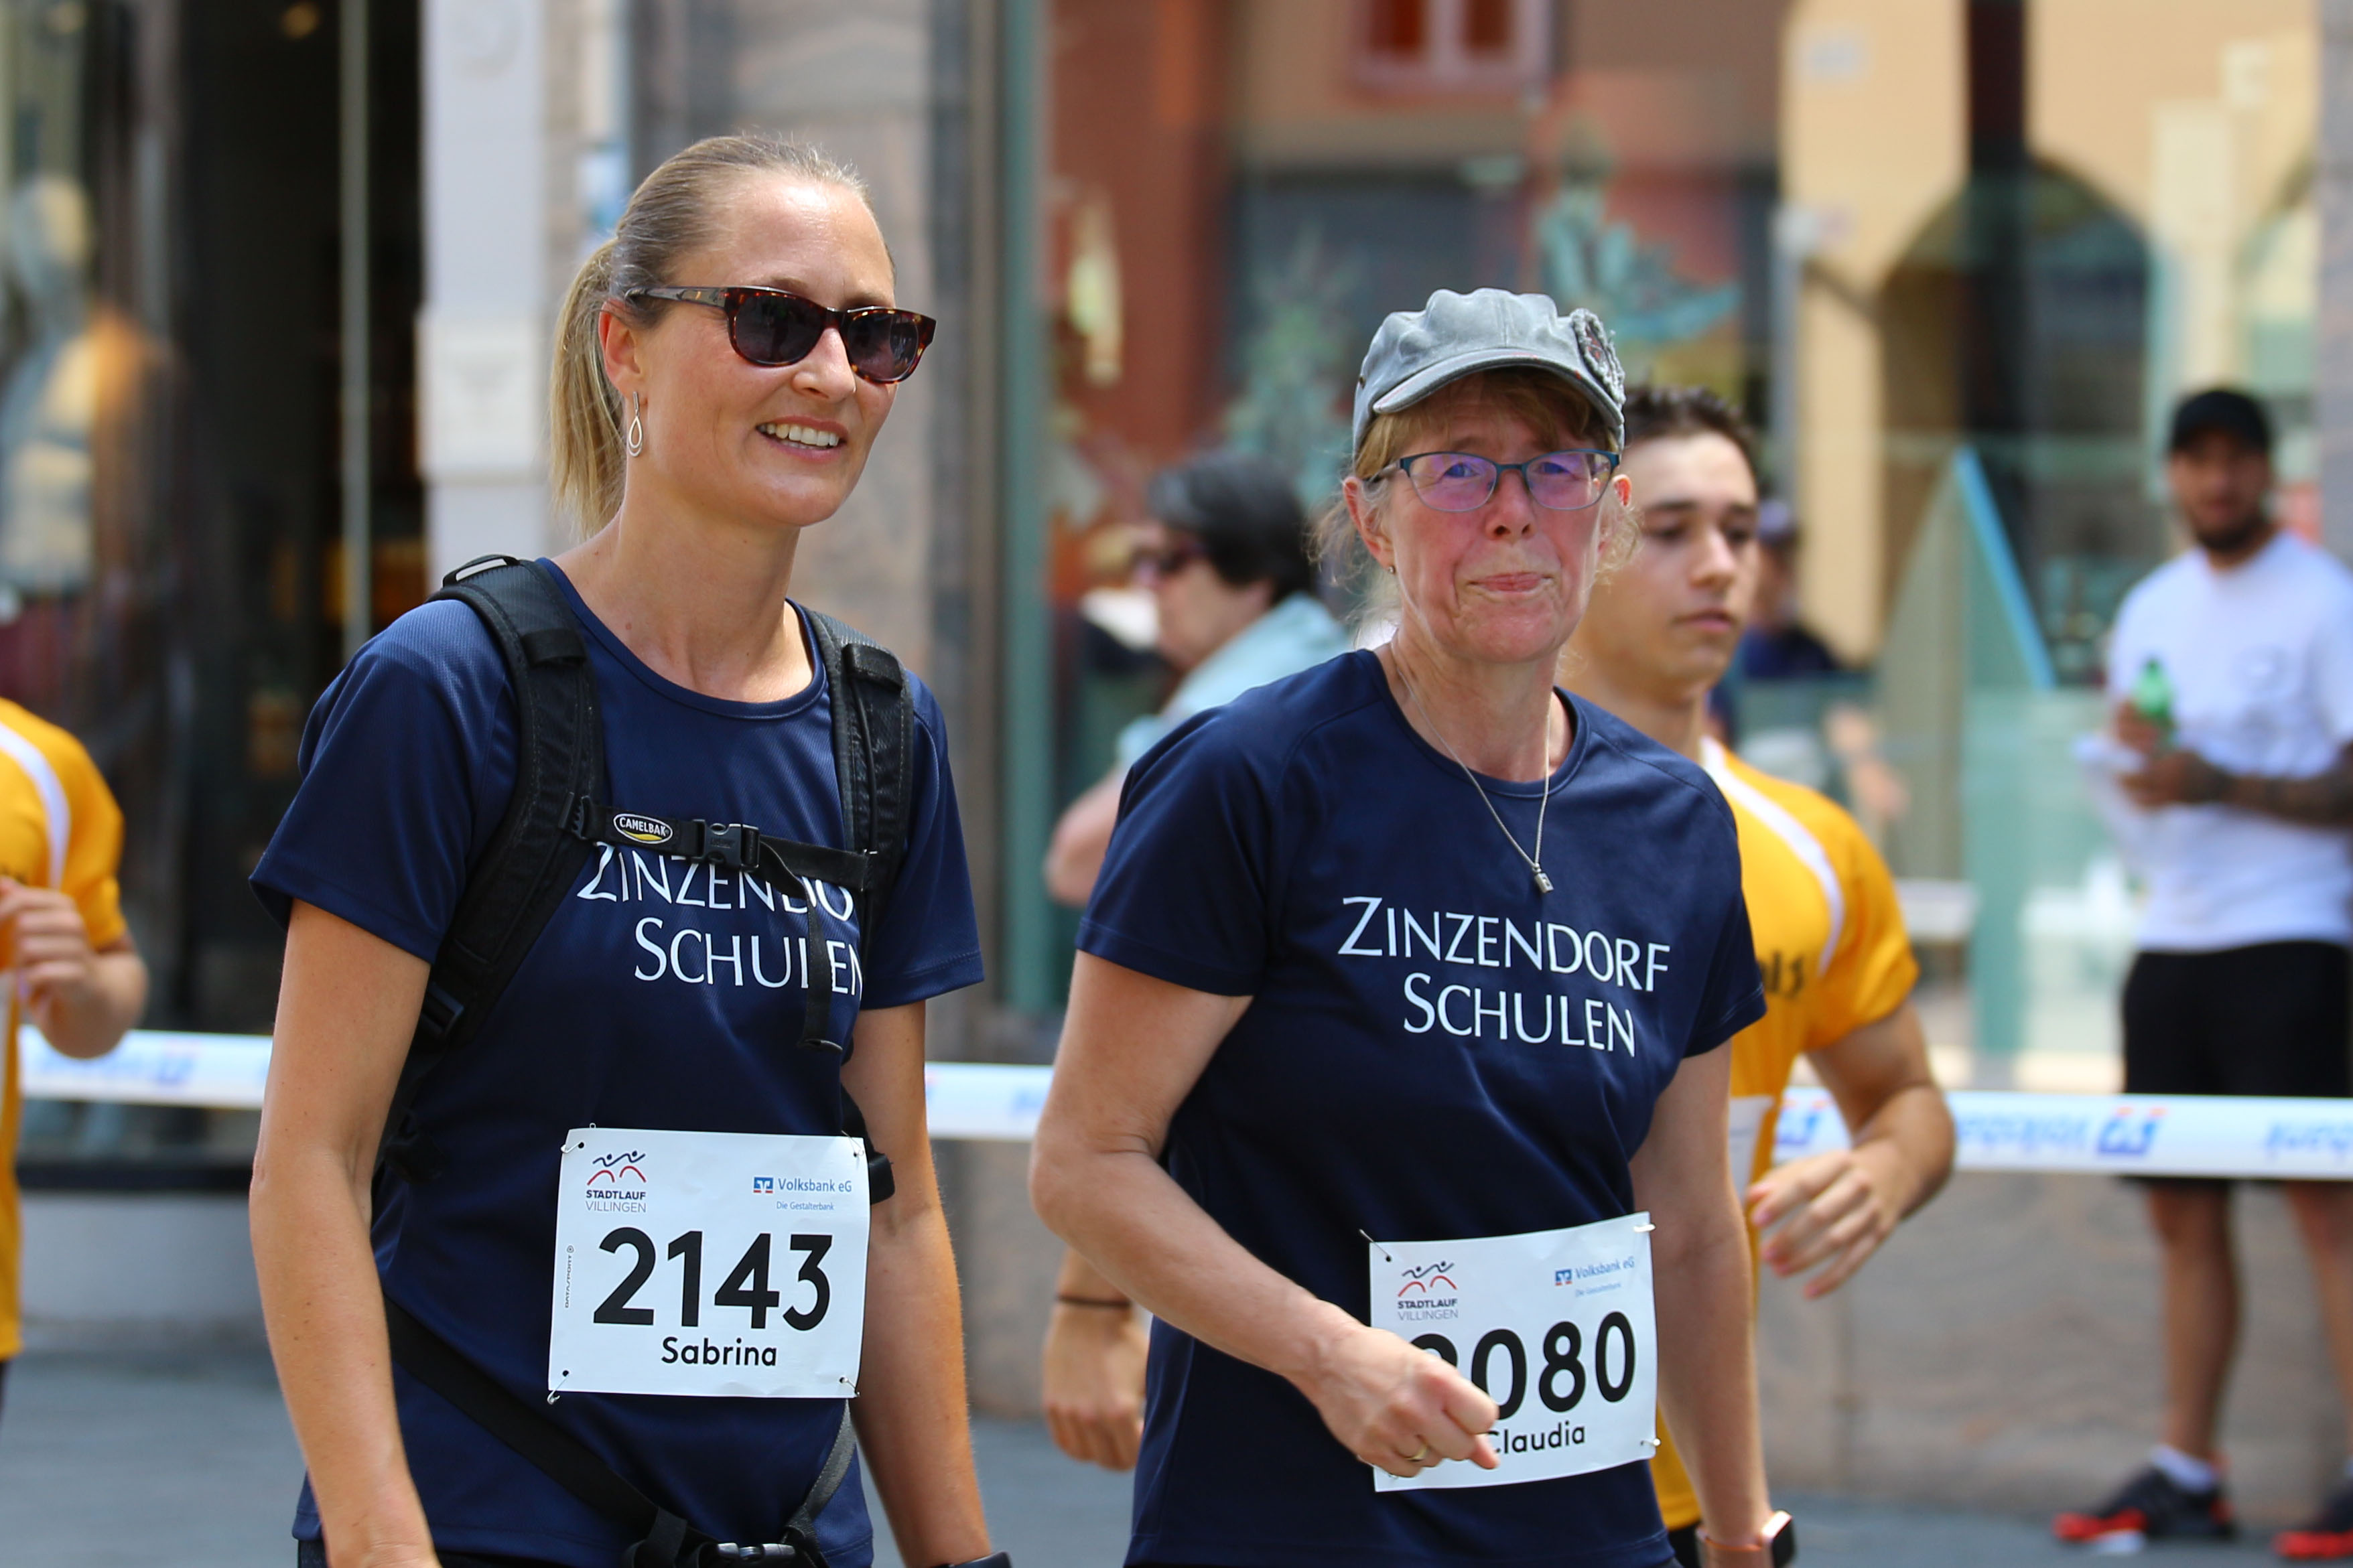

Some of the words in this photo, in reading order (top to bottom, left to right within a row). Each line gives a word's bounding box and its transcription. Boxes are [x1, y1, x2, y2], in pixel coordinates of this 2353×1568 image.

[619, 816, 666, 837] CAMELBAK
[1338, 896, 1670, 991] ZINZENDORF
[1403, 972, 1635, 1058] SCHULEN
[777, 1178, 835, 1192] Volksbank
[838, 1180, 852, 1192] eG
[586, 1190, 647, 1200] STADTLAUF
[585, 1200, 647, 1213] VILLINGEN
[776, 1201, 788, 1210] Die
[593, 1226, 833, 1332] 2143
[1397, 1298, 1458, 1309] STADTLAUF
[1397, 1308, 1459, 1321] VILLINGEN
[661, 1336, 777, 1366] Sabrina
